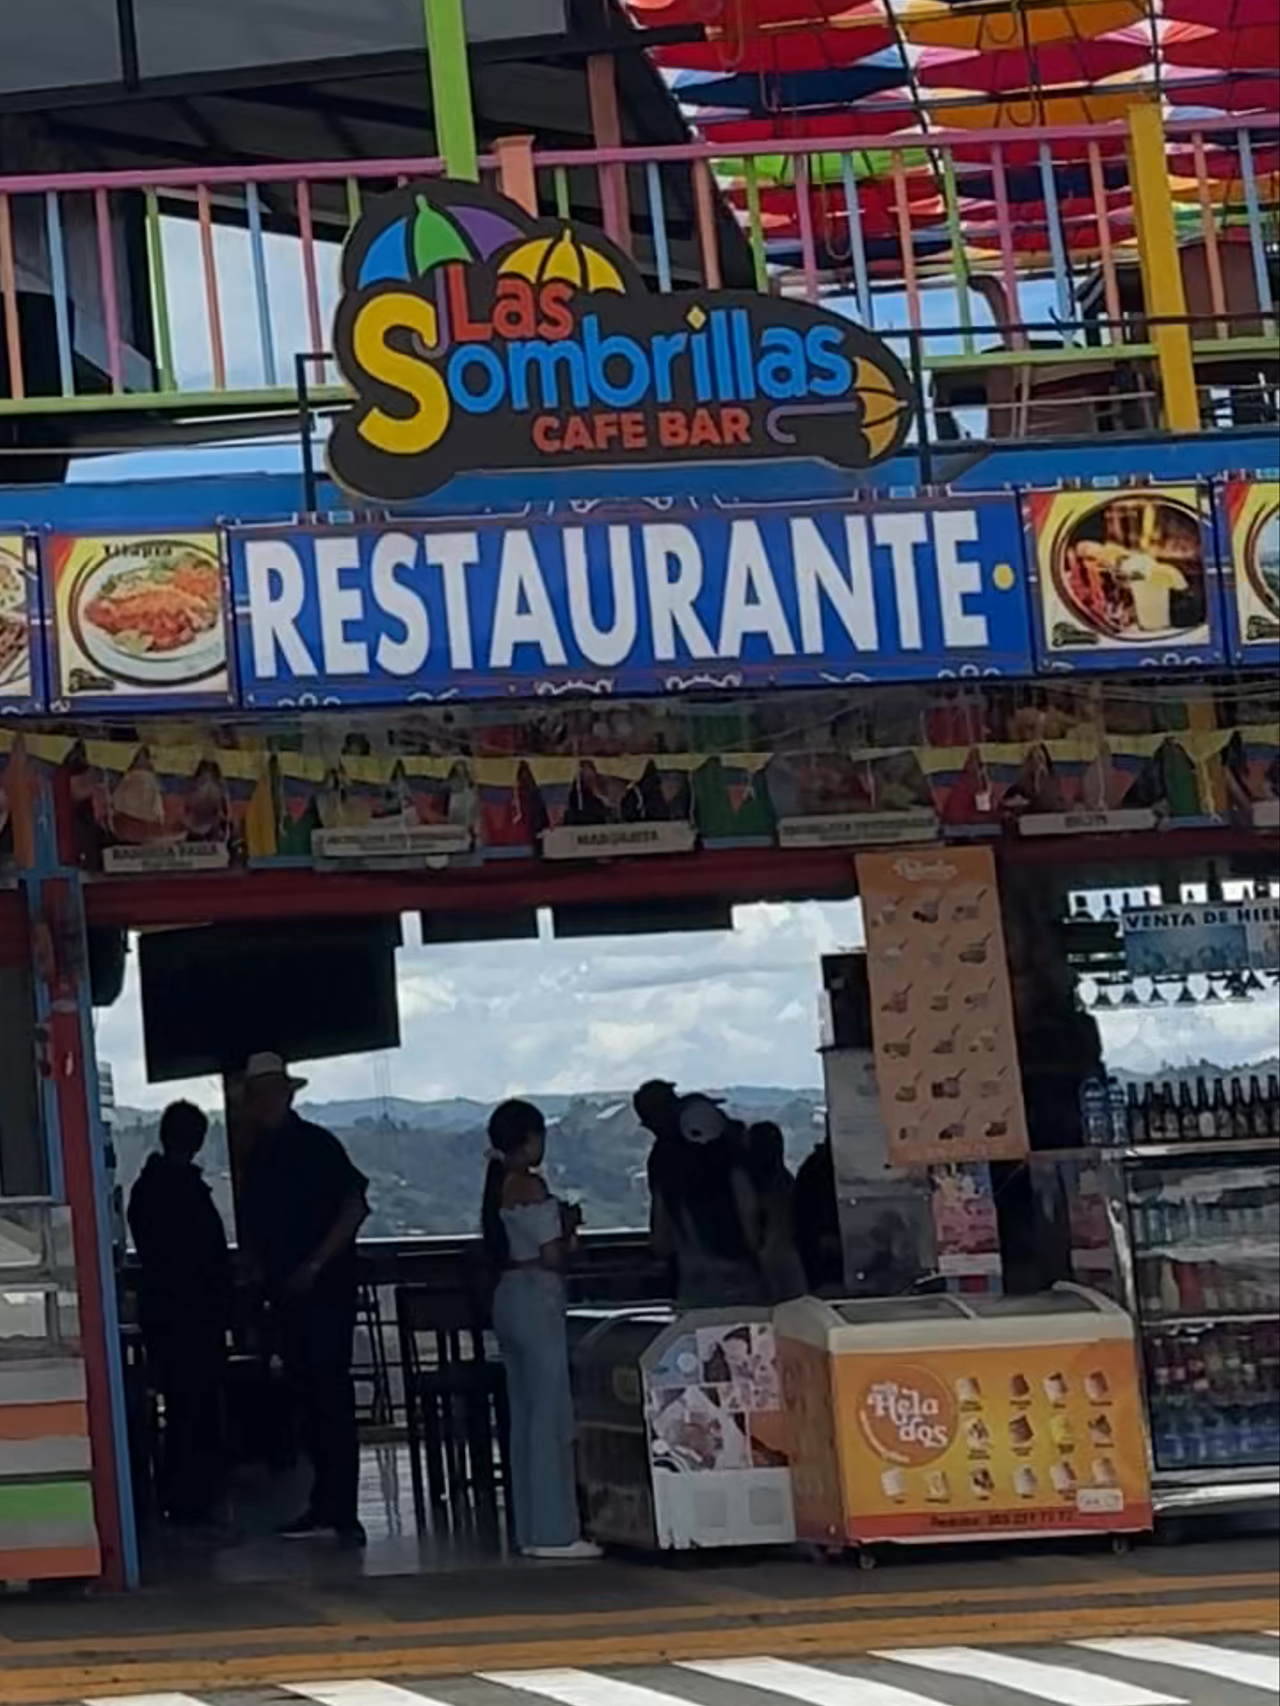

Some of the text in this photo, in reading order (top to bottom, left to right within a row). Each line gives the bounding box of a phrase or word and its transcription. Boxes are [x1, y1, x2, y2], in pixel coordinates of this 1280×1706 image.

[446, 263, 574, 344] Las
[351, 290, 856, 456] Sombrillas
[531, 406, 752, 453] CAFE BAR
[243, 509, 991, 680] RESTAURANTE
[1126, 911, 1196, 928] VENTA
[1203, 910, 1229, 925] DE
